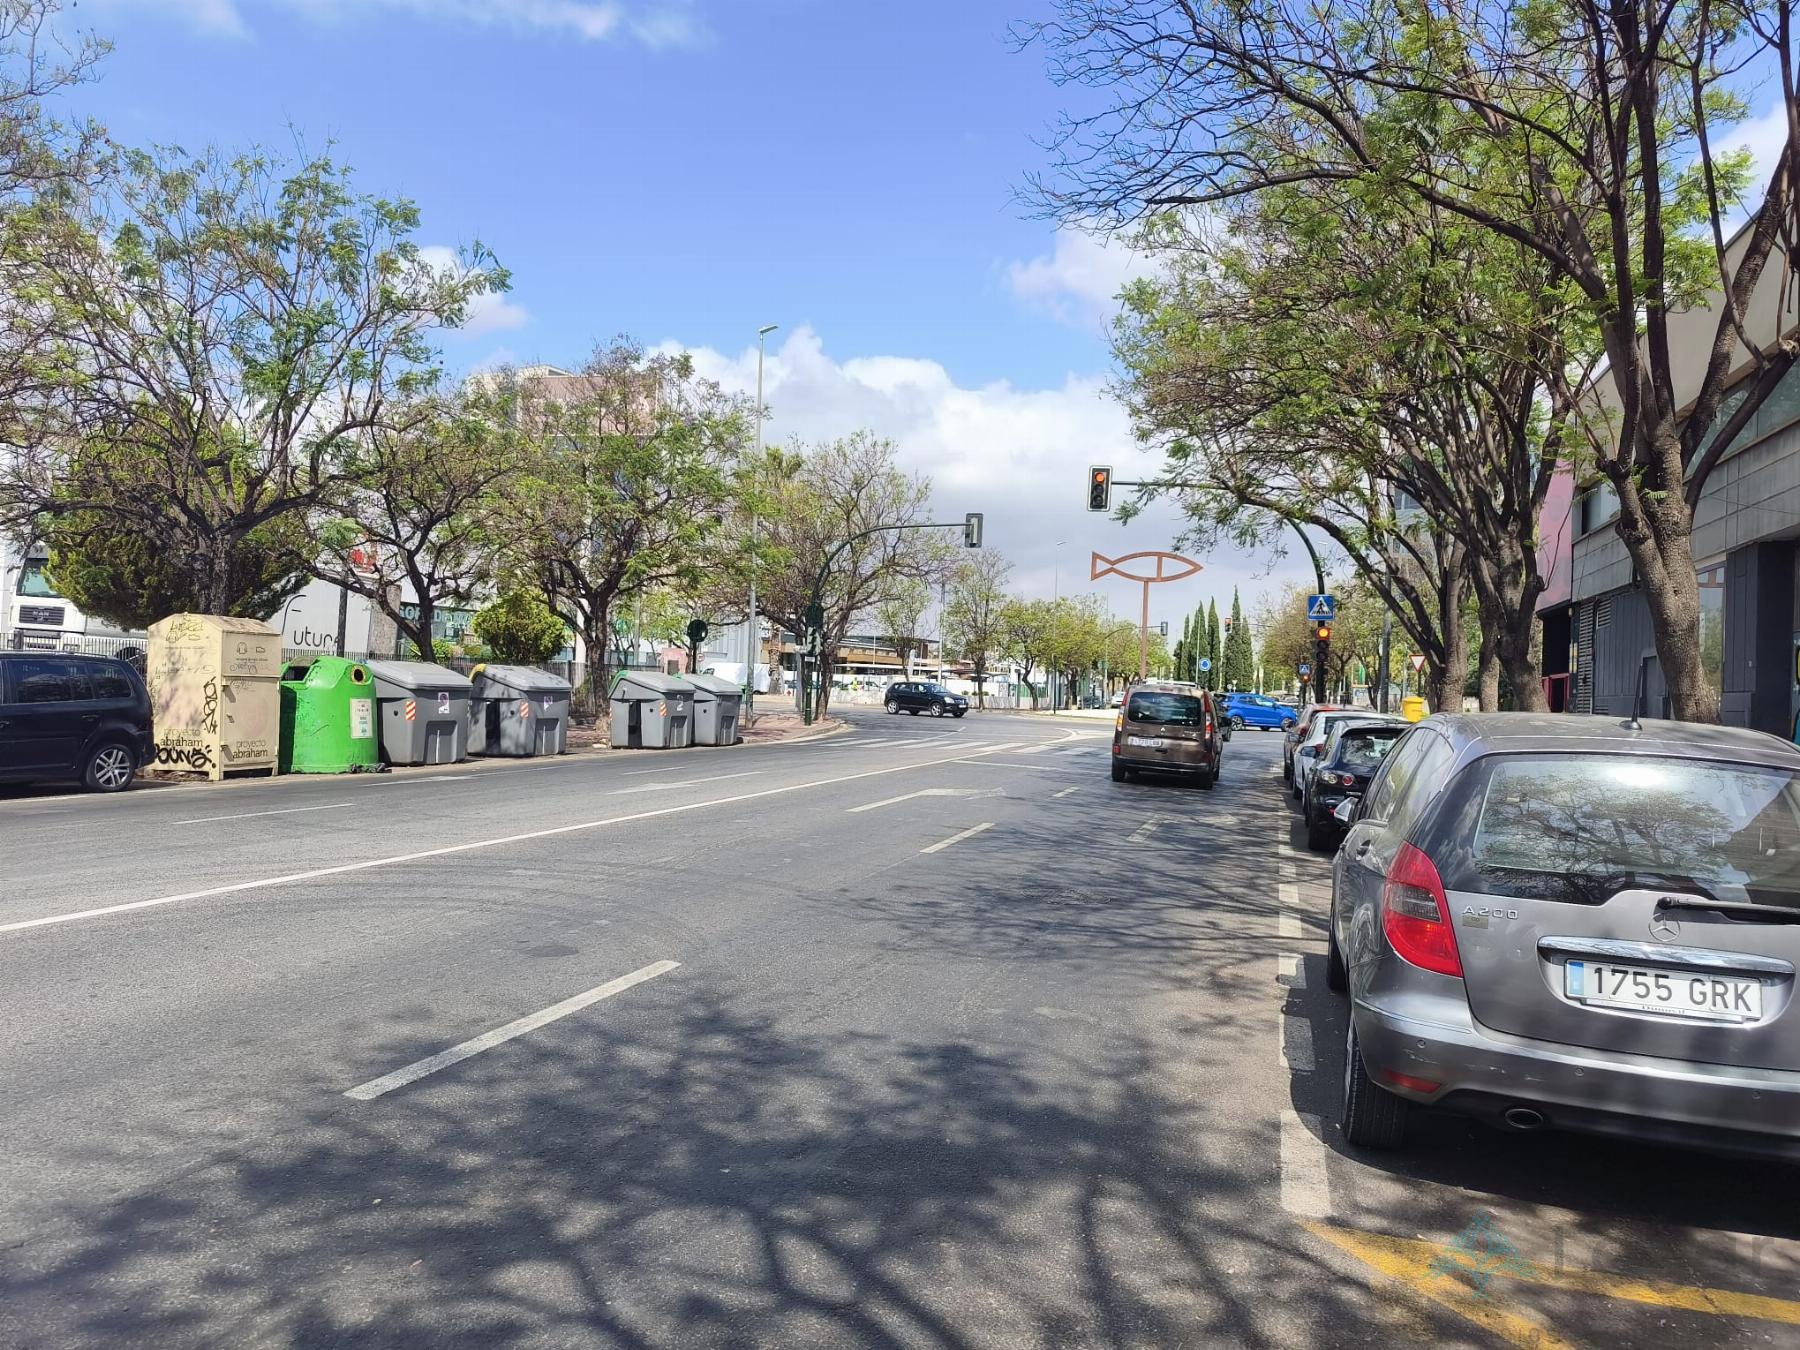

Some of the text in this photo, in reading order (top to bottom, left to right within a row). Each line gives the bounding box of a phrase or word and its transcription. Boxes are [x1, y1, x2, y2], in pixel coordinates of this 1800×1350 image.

[160, 736, 203, 747] abraham
[233, 748, 268, 759] abraham
[1594, 966, 1753, 1012] 1755 GRK
